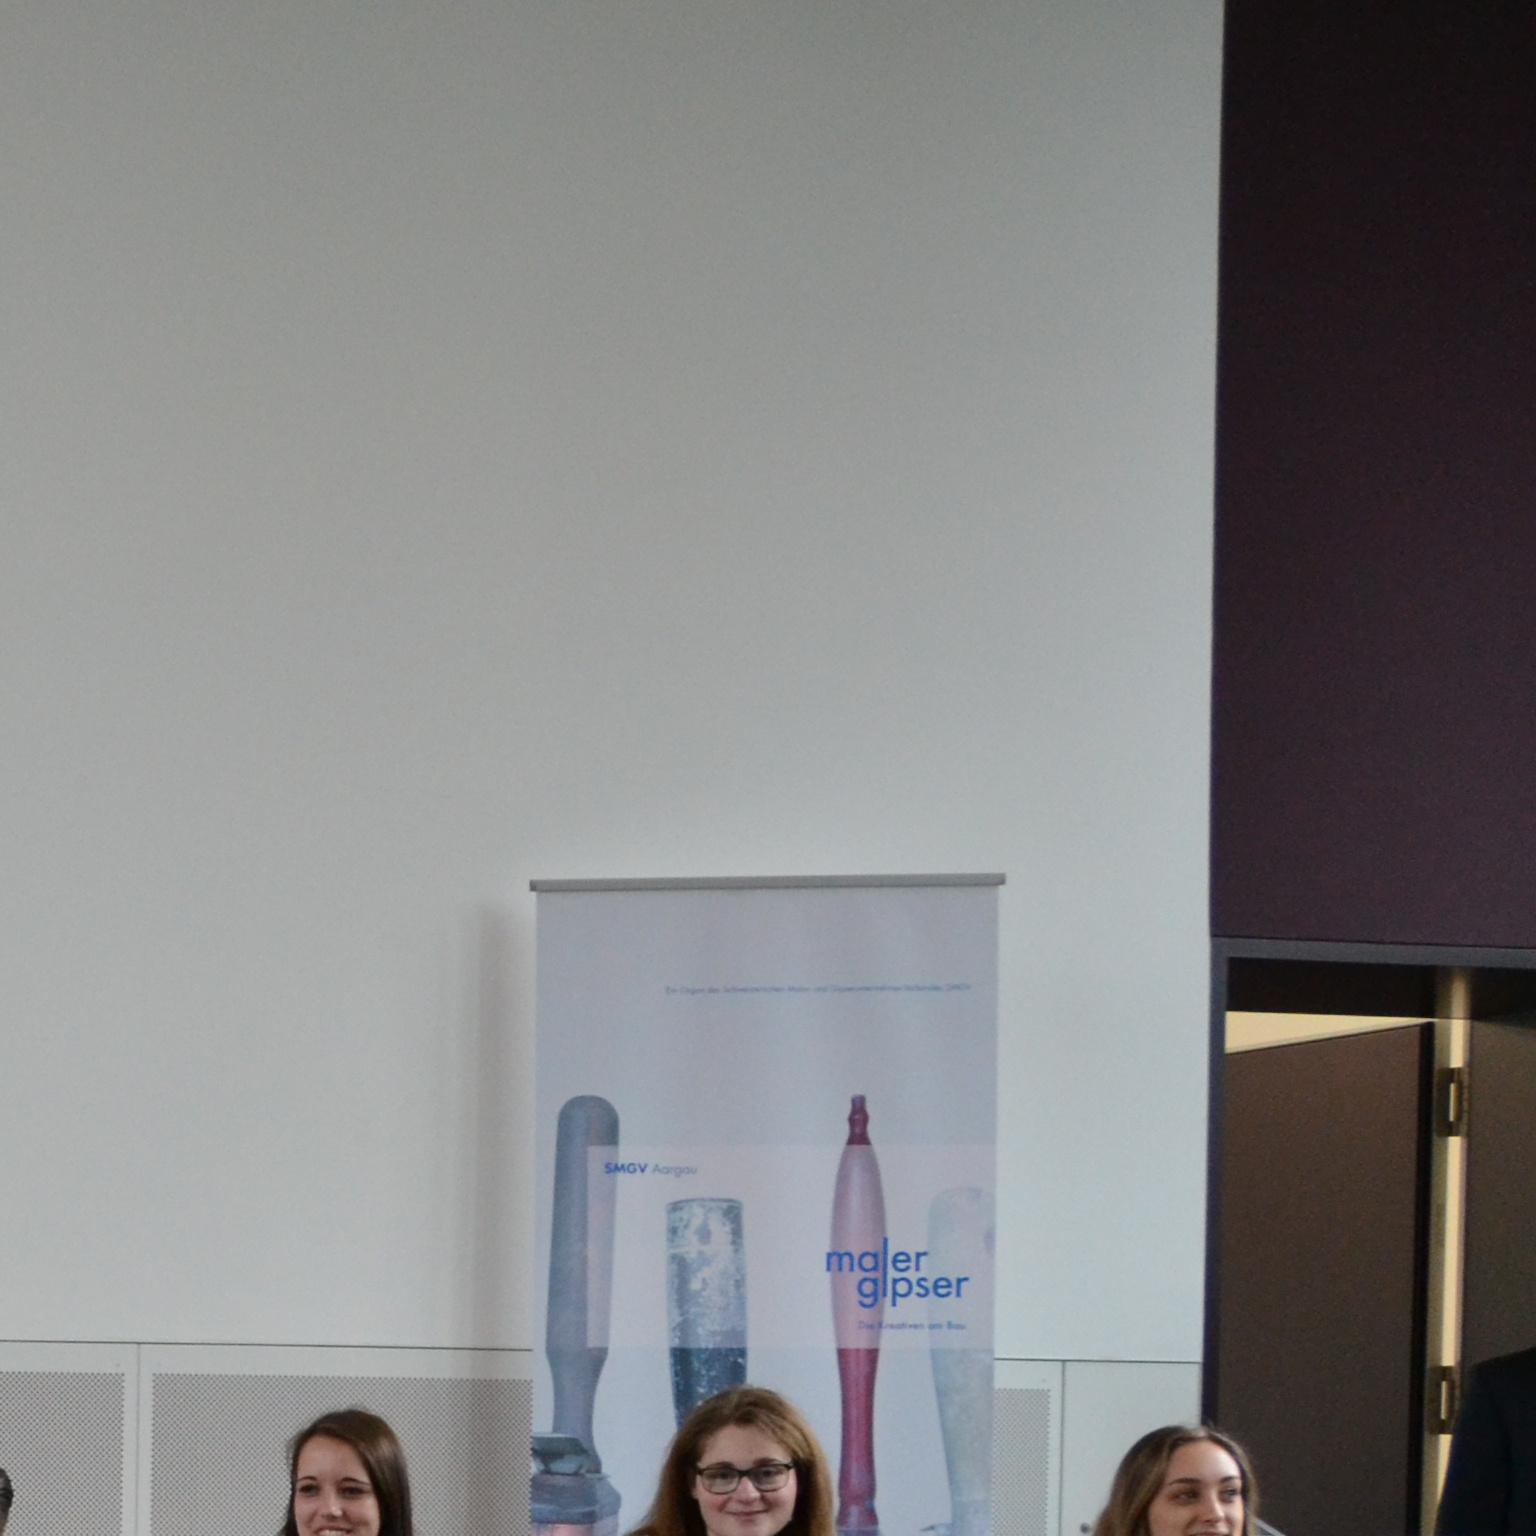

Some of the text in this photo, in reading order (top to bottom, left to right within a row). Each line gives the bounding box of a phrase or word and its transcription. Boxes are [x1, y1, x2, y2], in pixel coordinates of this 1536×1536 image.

[604, 1162, 698, 1178] SMGV Aargau
[825, 1237, 929, 1272] maler
[856, 1277, 970, 1309] gipser
[858, 1321, 875, 1330] Die
